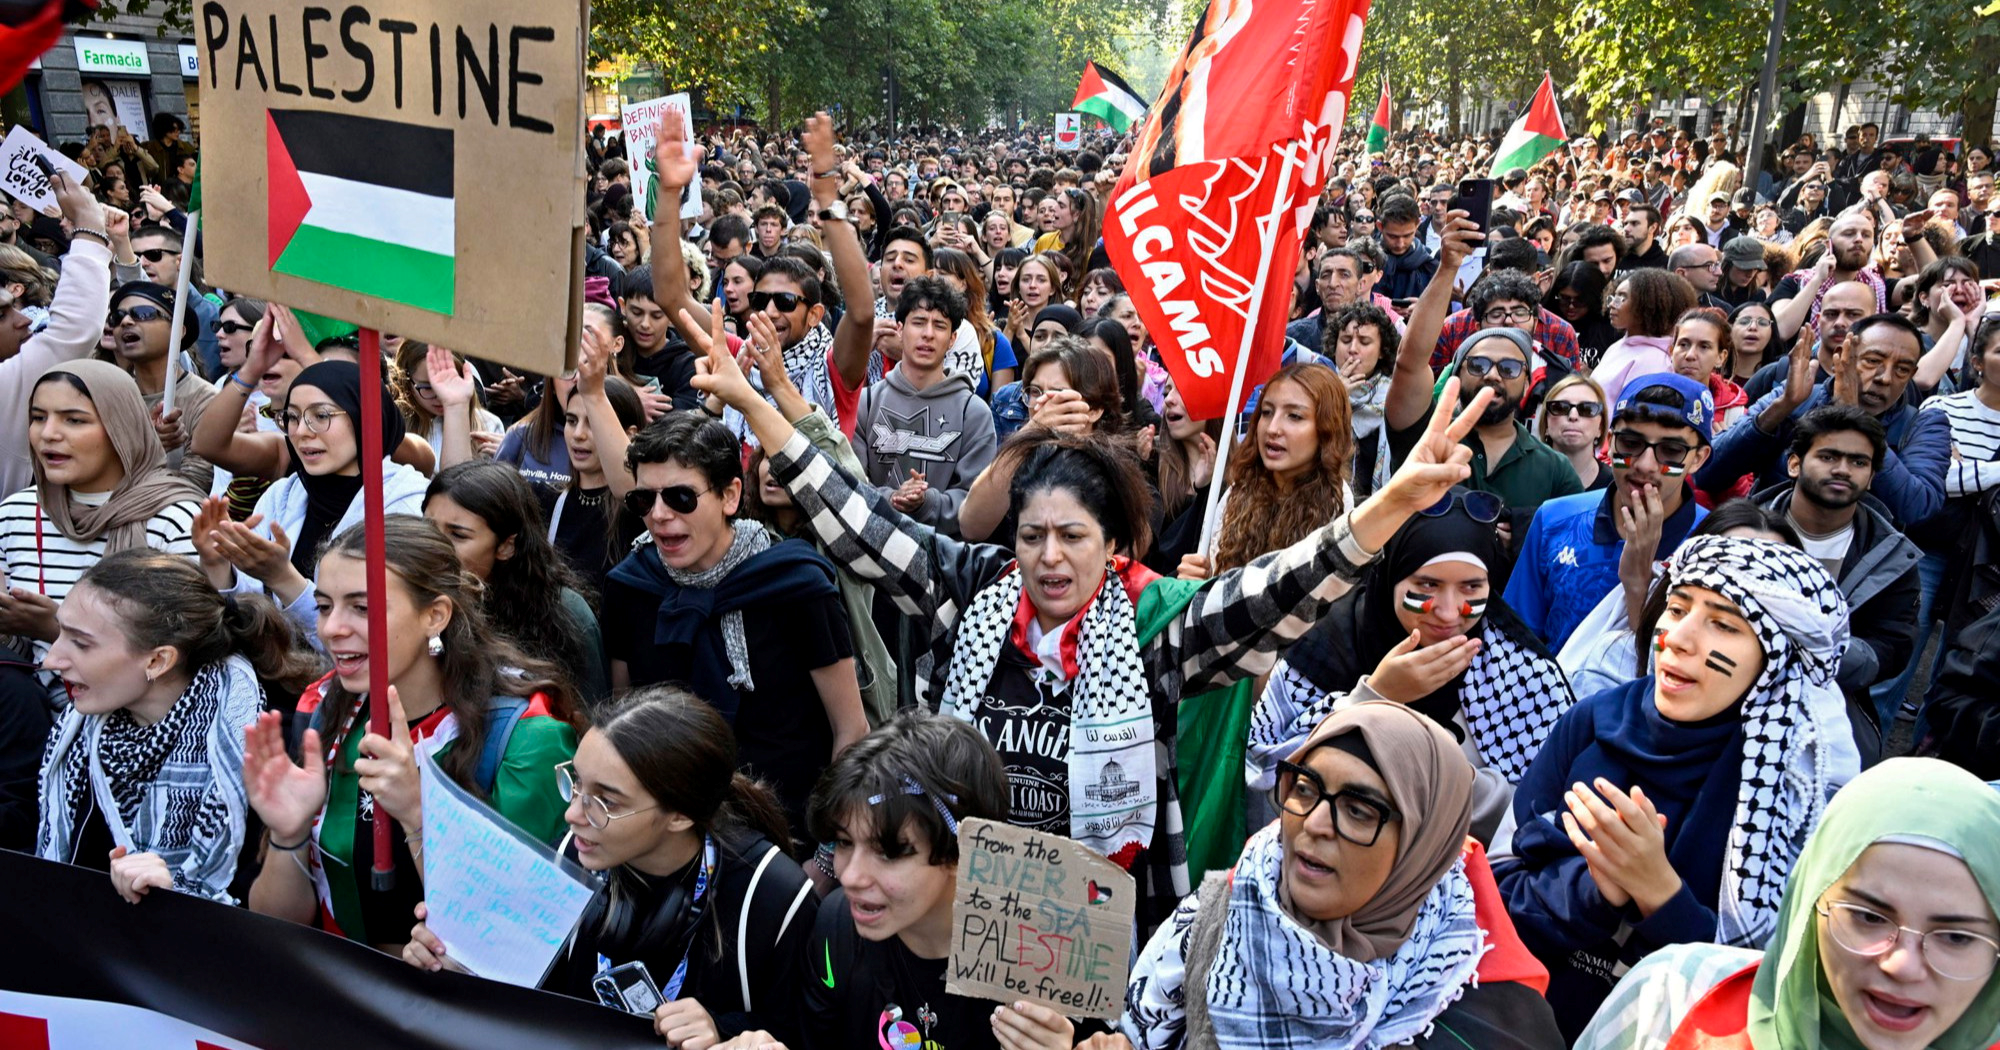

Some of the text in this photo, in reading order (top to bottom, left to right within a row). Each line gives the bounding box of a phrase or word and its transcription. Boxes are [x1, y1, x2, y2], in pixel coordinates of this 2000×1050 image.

[84, 50, 142, 67] Farmacia
[203, 1, 555, 134] PALESTINE
[550, 471, 571, 482] Hom
[995, 719, 1070, 764] ANGE
[1020, 786, 1063, 812] COAST
[969, 824, 1062, 865] from the
[966, 850, 1067, 898] RIVER
[965, 887, 1091, 937] to the SEA
[962, 914, 1113, 982] PALESTINE
[1004, 966, 1030, 994] be
